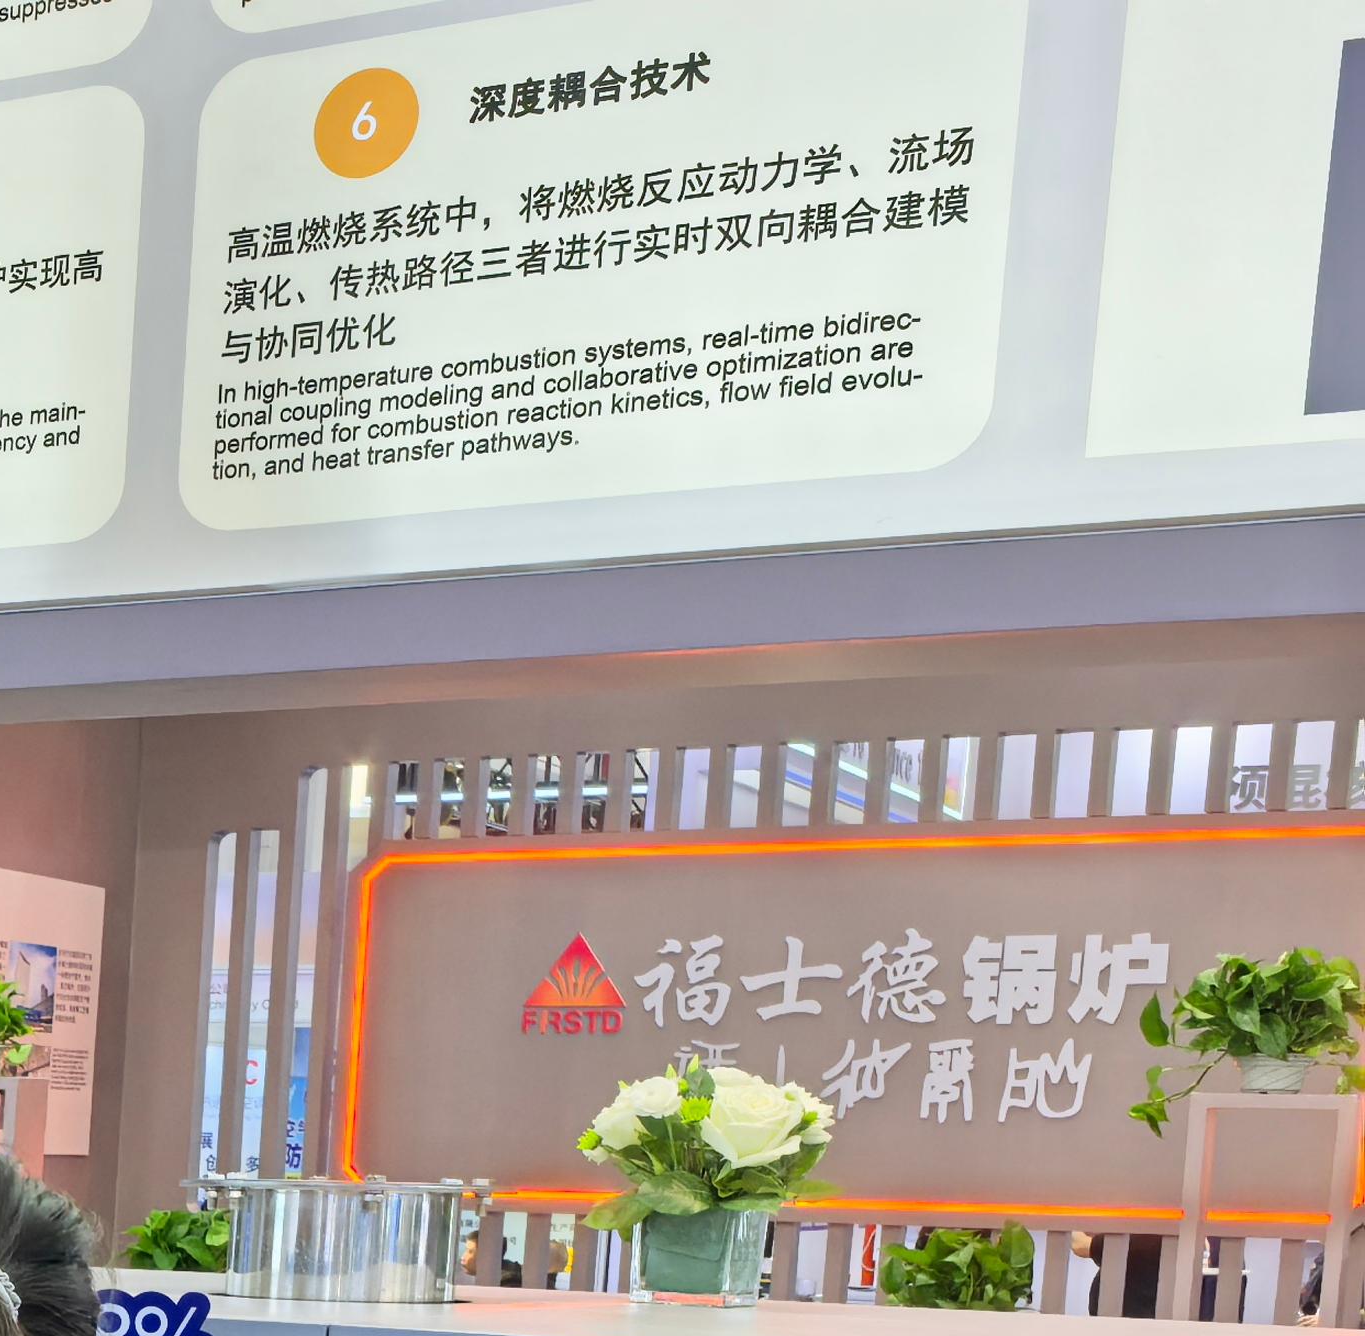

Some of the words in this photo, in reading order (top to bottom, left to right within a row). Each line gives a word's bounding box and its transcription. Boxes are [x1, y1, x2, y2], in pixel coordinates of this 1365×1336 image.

[351, 103, 377, 143] 6
[469, 50, 712, 123] 深度耦合技术
[227, 125, 975, 264] 高温燃烧系统中，将燃烧反应动力学、流场
[223, 183, 971, 315] 演化、传热路径三者进行实时双向耦合建模
[218, 383, 237, 405] In
[243, 365, 433, 408] high-temperature
[440, 346, 576, 379] combustion
[584, 336, 692, 371] systems,
[702, 321, 815, 351] real-time
[823, 311, 922, 338] bidirec-
[220, 311, 396, 365] 与协同优化
[29, 405, 86, 425] main-
[213, 418, 325, 461] performed
[330, 422, 362, 444] for
[366, 407, 499, 440] combustion
[507, 399, 603, 425] reaction
[610, 388, 710, 415] kinetics,
[719, 380, 772, 404] flow
[778, 370, 833, 399] field
[841, 364, 924, 392] evolu-
[215, 398, 274, 430] tional
[279, 391, 372, 428] coupling
[379, 383, 484, 413] modeling
[490, 374, 536, 401] and
[543, 361, 698, 395] collaborative
[706, 344, 861, 382] optimization
[870, 340, 914, 362] are
[42, 424, 81, 448] and
[211, 458, 257, 481] tion,
[263, 451, 305, 476] and
[311, 447, 361, 472] heat
[366, 438, 455, 466] transfer
[460, 429, 580, 461] pathways.
[632, 927, 1170, 1029] 福士德锅炉
[521, 1008, 624, 1035] FIRSTD
